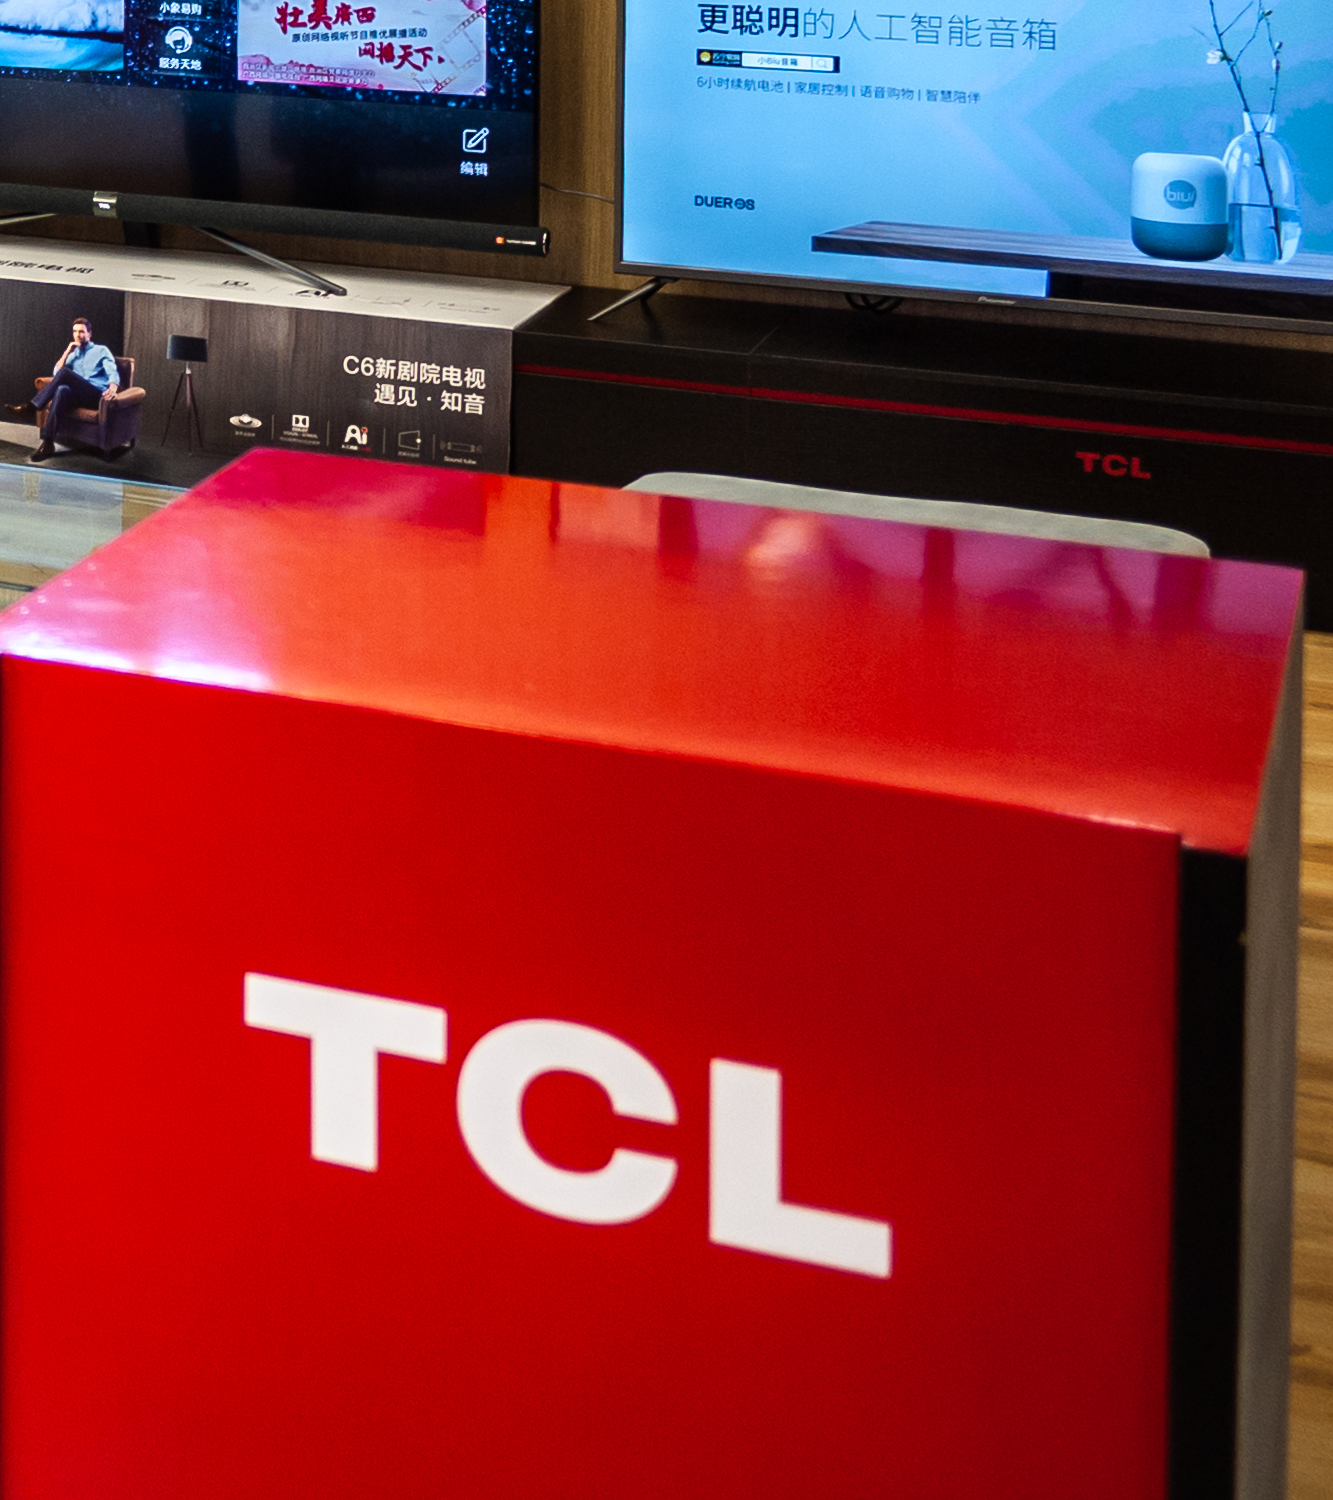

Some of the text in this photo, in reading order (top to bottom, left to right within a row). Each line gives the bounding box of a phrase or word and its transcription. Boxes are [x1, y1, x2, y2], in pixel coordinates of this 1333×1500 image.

[697, 3, 1058, 52] 更聪明的人工智能音箱
[159, 57, 202, 70] 服务天地
[696, 77, 981, 105] 6小时续航电池 家居控制 语音购物 智慧陪伴
[459, 161, 488, 176] 编辑
[342, 354, 486, 390] C6新剧院电视
[1076, 452, 1151, 478] TCL
[244, 971, 893, 1280] TCL
